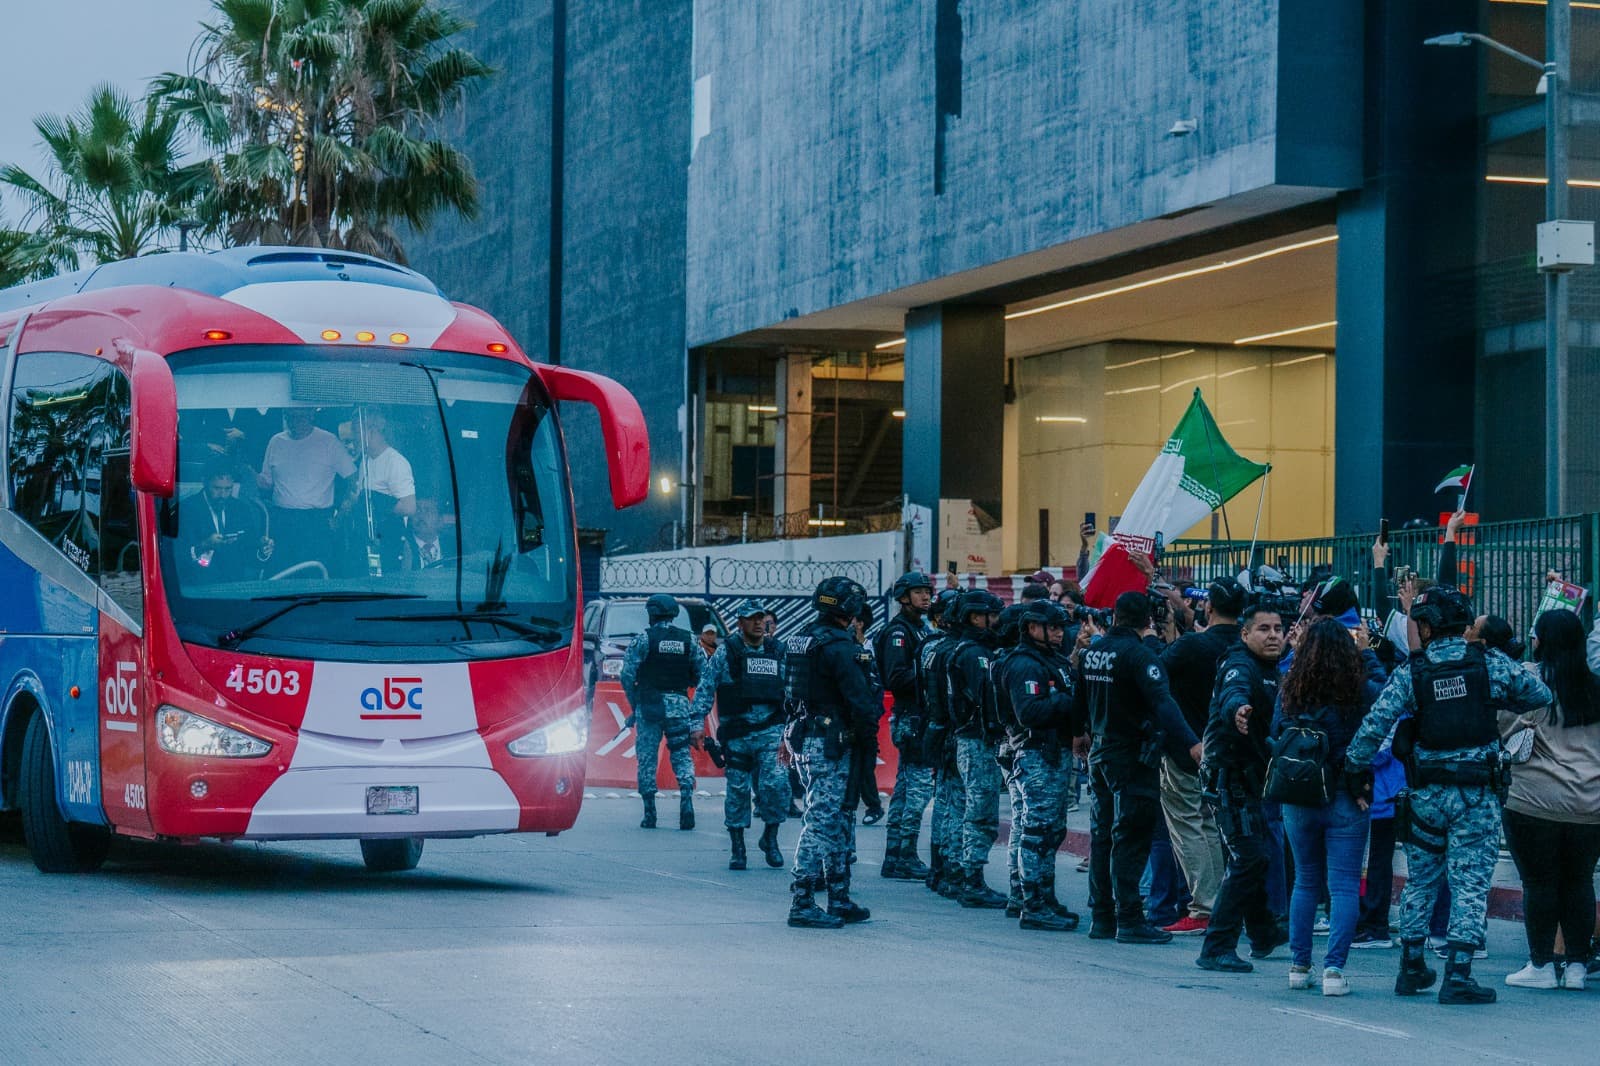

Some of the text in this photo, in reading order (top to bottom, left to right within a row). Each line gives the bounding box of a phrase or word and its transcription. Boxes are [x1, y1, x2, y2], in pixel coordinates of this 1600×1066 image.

[1084, 650, 1117, 670] SSPC
[106, 661, 137, 715] abc
[226, 664, 300, 695] 4503
[1435, 678, 1465, 689] GUARDIA
[1435, 686, 1467, 698] NACIONAL
[361, 677, 423, 711] abc
[124, 783, 145, 809] 4503
